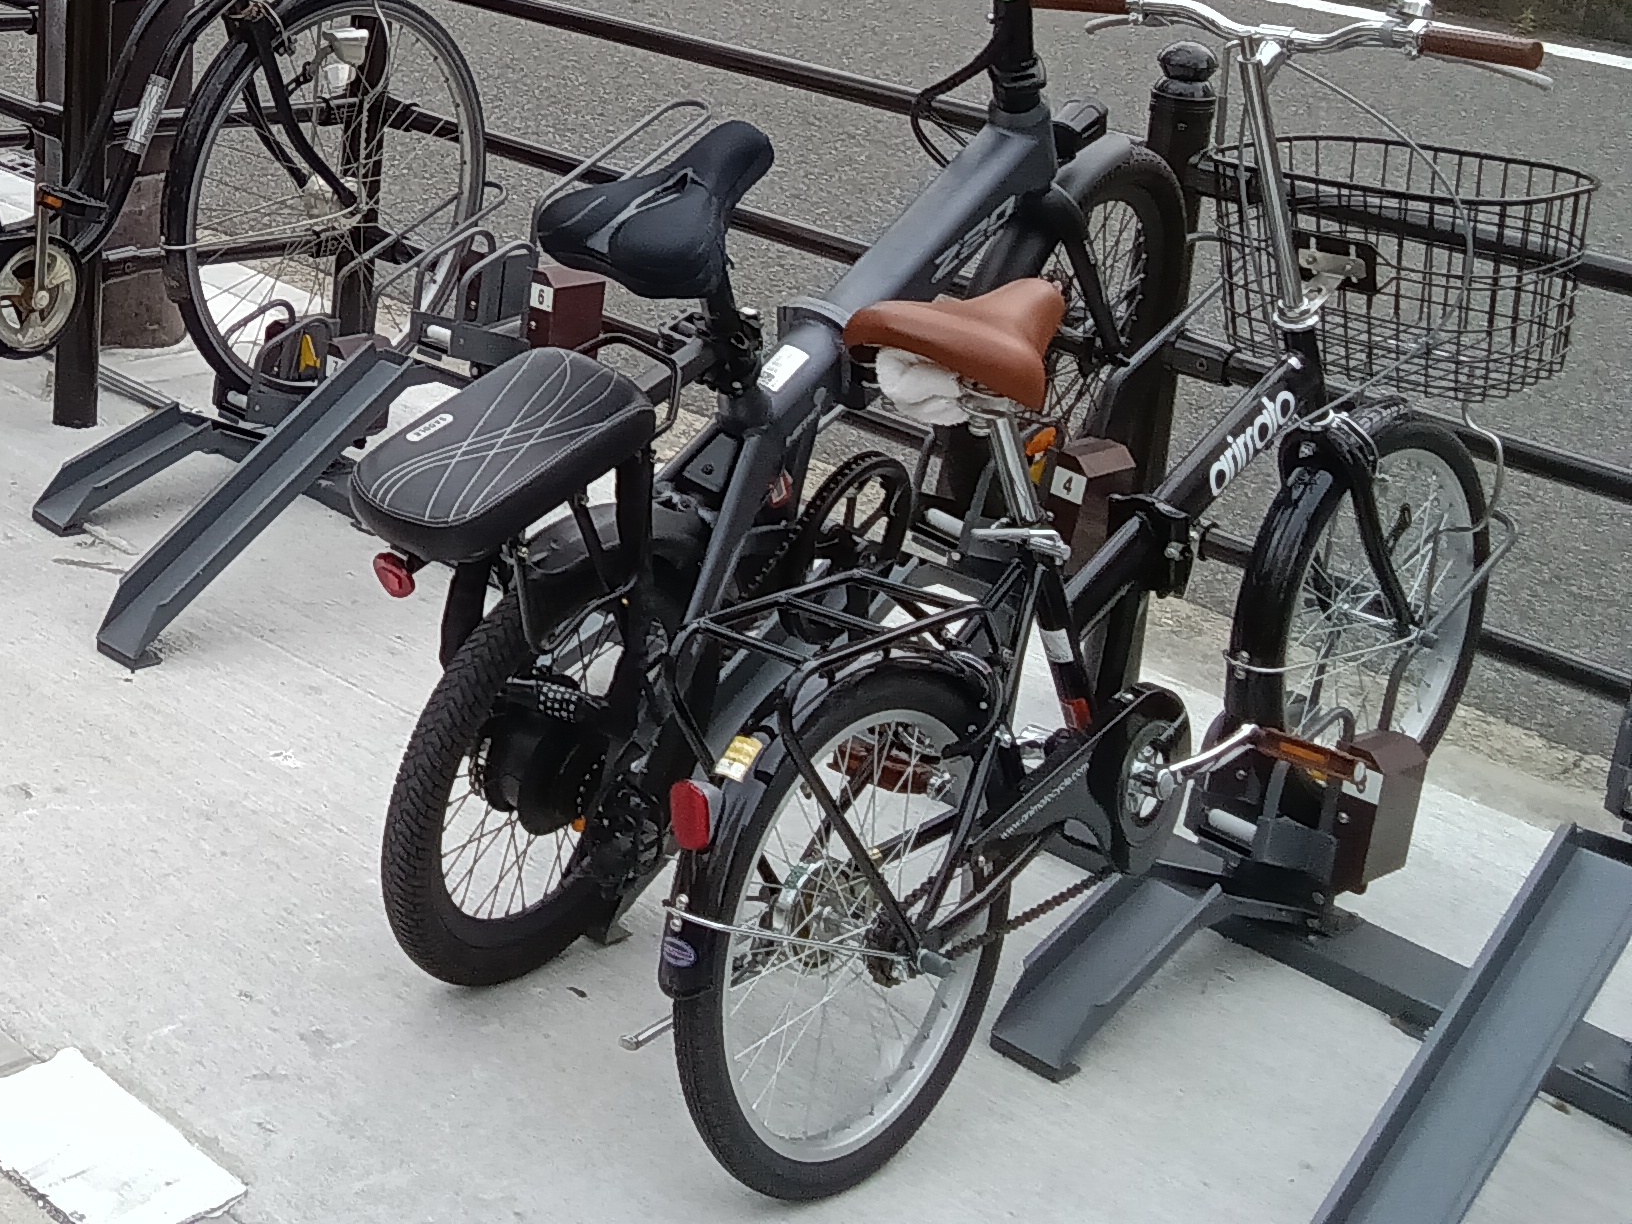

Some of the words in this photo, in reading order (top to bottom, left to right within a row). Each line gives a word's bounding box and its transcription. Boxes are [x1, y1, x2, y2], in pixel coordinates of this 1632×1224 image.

[537, 288, 545, 306] 6
[1209, 390, 1296, 497] animato
[1062, 475, 1074, 496] 4
